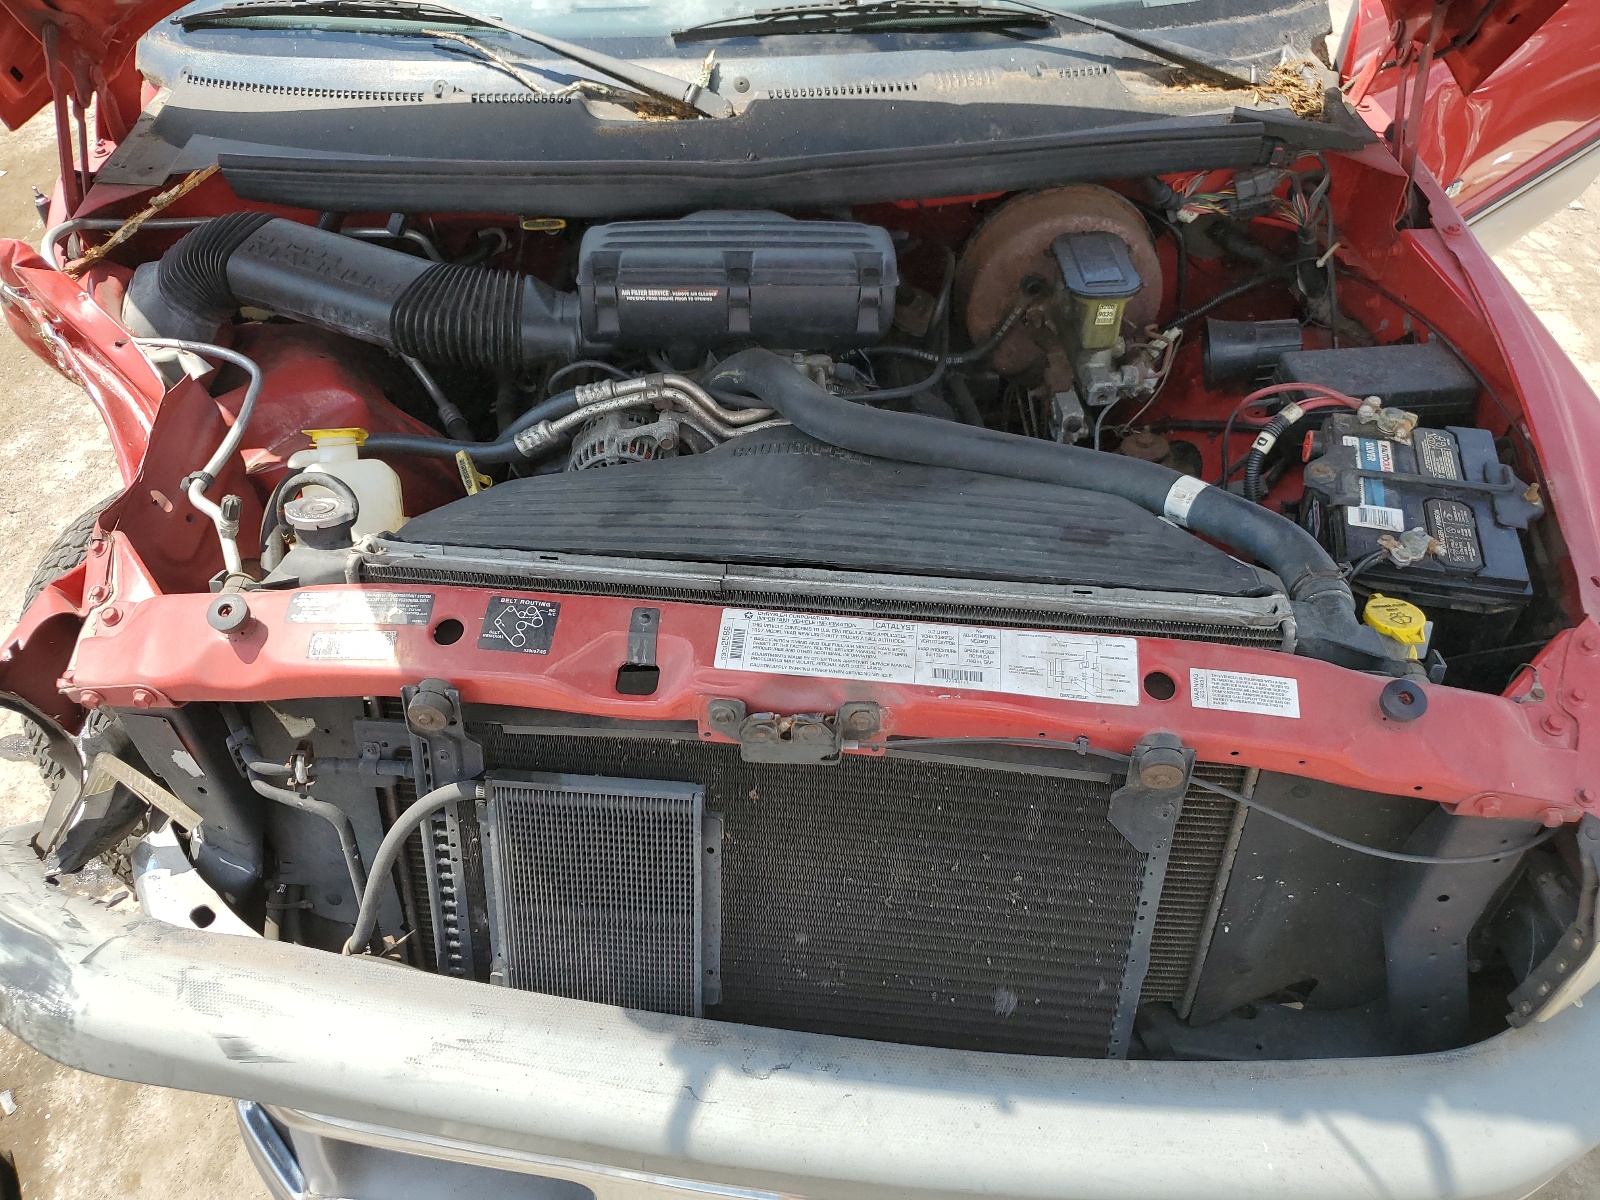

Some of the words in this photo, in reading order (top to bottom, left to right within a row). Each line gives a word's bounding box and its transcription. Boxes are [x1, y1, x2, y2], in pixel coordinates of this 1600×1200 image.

[1365, 442, 1376, 461] SILVER
[520, 599, 551, 607] ROUTING
[875, 622, 916, 631] CATALYST
